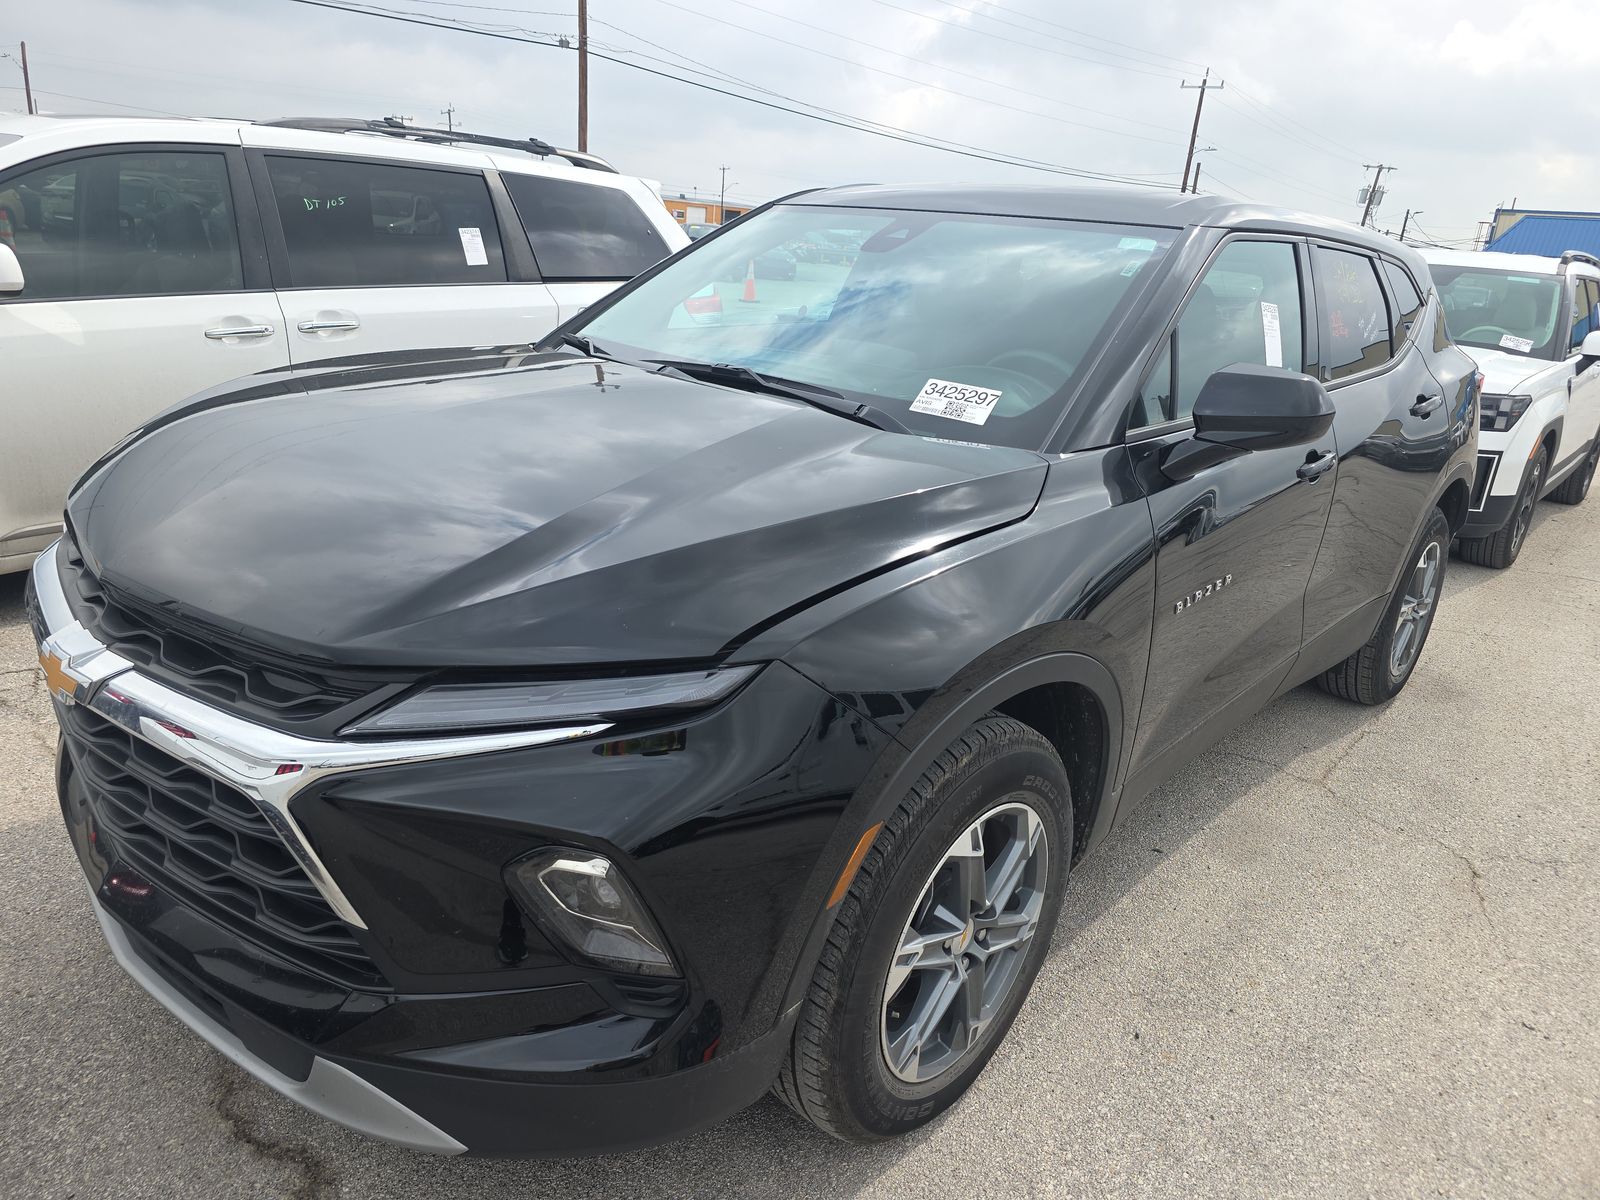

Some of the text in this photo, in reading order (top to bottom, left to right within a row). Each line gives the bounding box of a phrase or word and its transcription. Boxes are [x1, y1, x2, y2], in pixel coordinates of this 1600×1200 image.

[303, 196, 347, 210] DT 105
[925, 383, 1000, 407] 3425297
[1175, 574, 1232, 614] BLAZER
